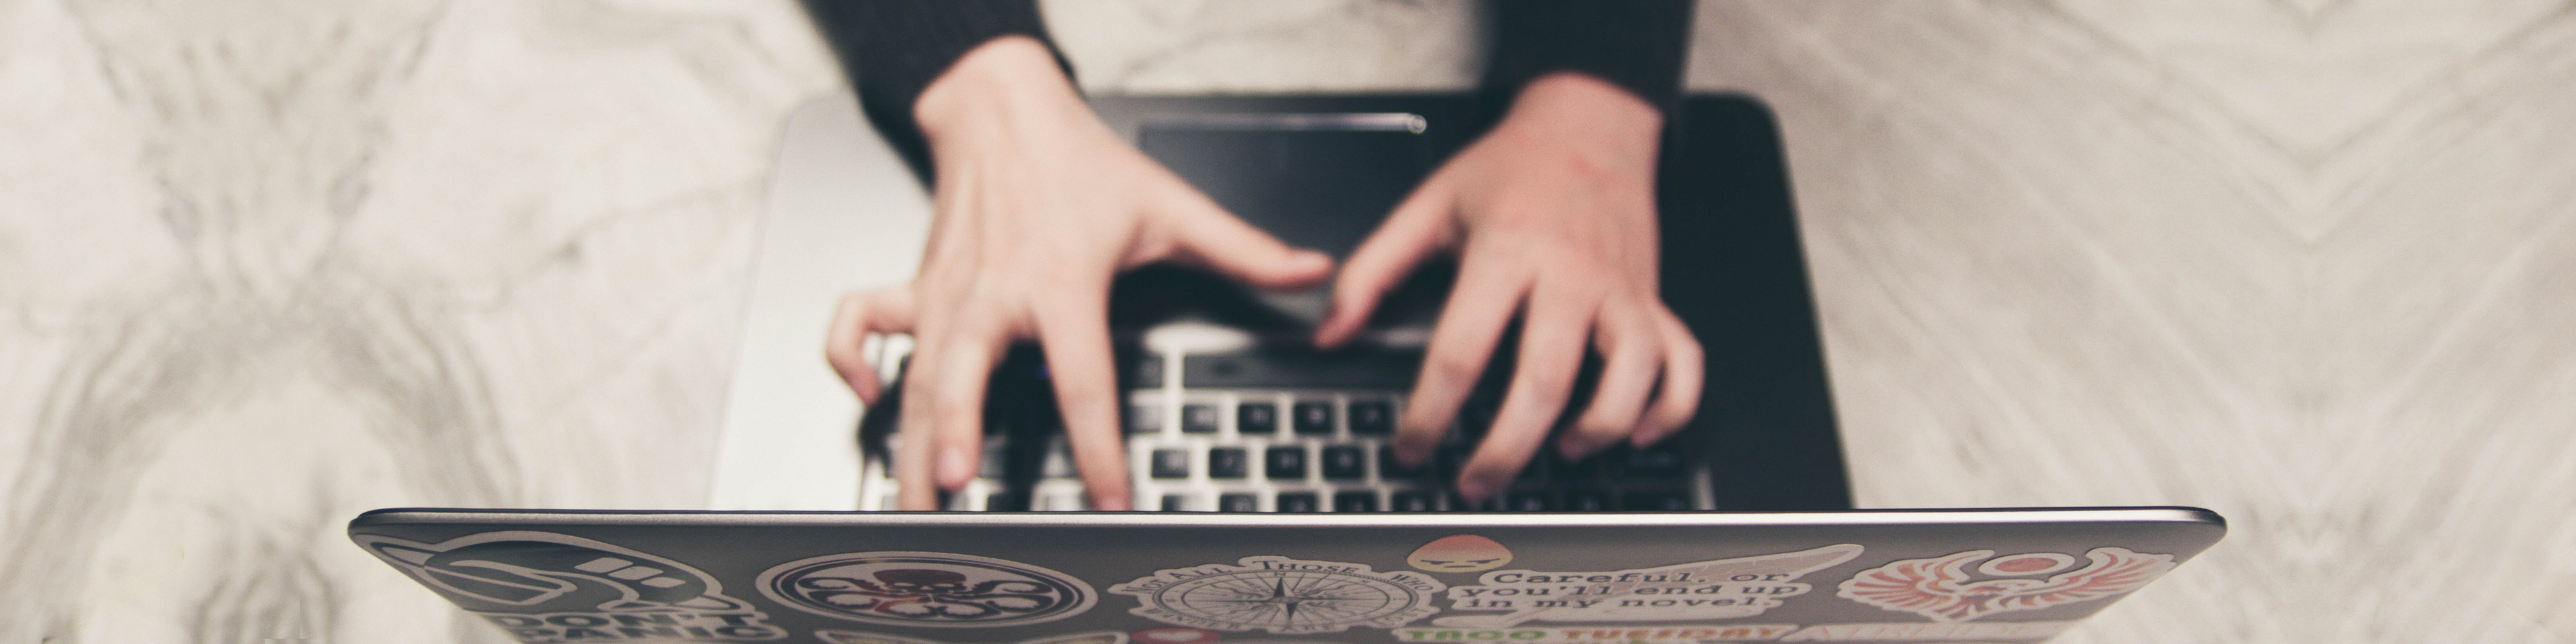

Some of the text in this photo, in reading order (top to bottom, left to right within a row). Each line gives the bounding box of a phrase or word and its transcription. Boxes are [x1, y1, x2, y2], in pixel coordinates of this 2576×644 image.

[1391, 574, 1432, 591] WHO
[1493, 572, 1790, 584] Careful, or
[1460, 584, 1799, 597] you'll end up
[1466, 597, 1773, 608] in my novel.
